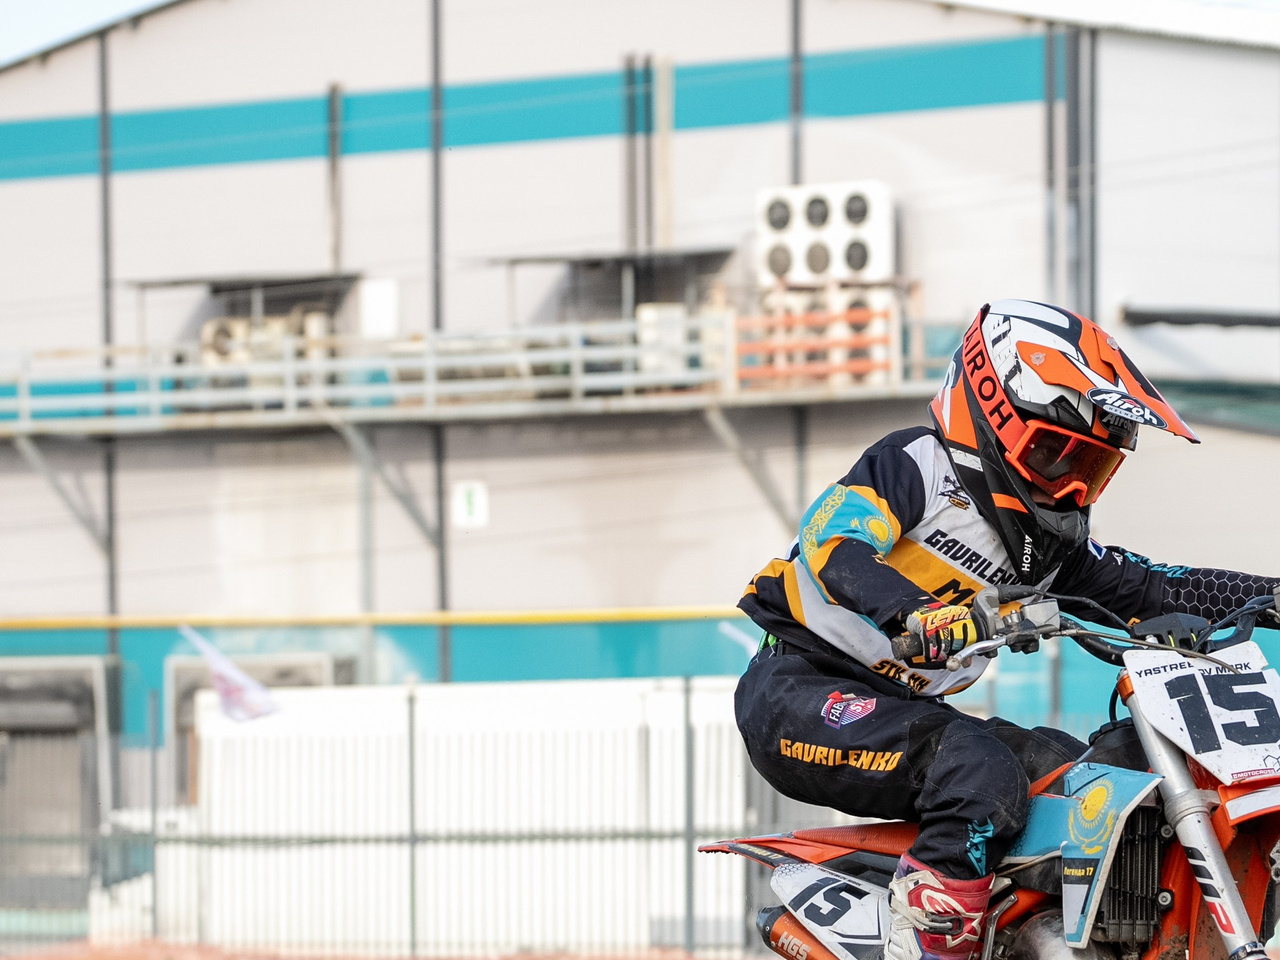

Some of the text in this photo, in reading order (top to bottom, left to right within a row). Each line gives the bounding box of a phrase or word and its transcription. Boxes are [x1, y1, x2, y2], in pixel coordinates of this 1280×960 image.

[964, 326, 1014, 432] AIROH
[1092, 393, 1158, 424] Airoh
[1021, 534, 1033, 572] AIROH
[780, 738, 904, 771] GAVRILENKO
[788, 876, 871, 927] 15
